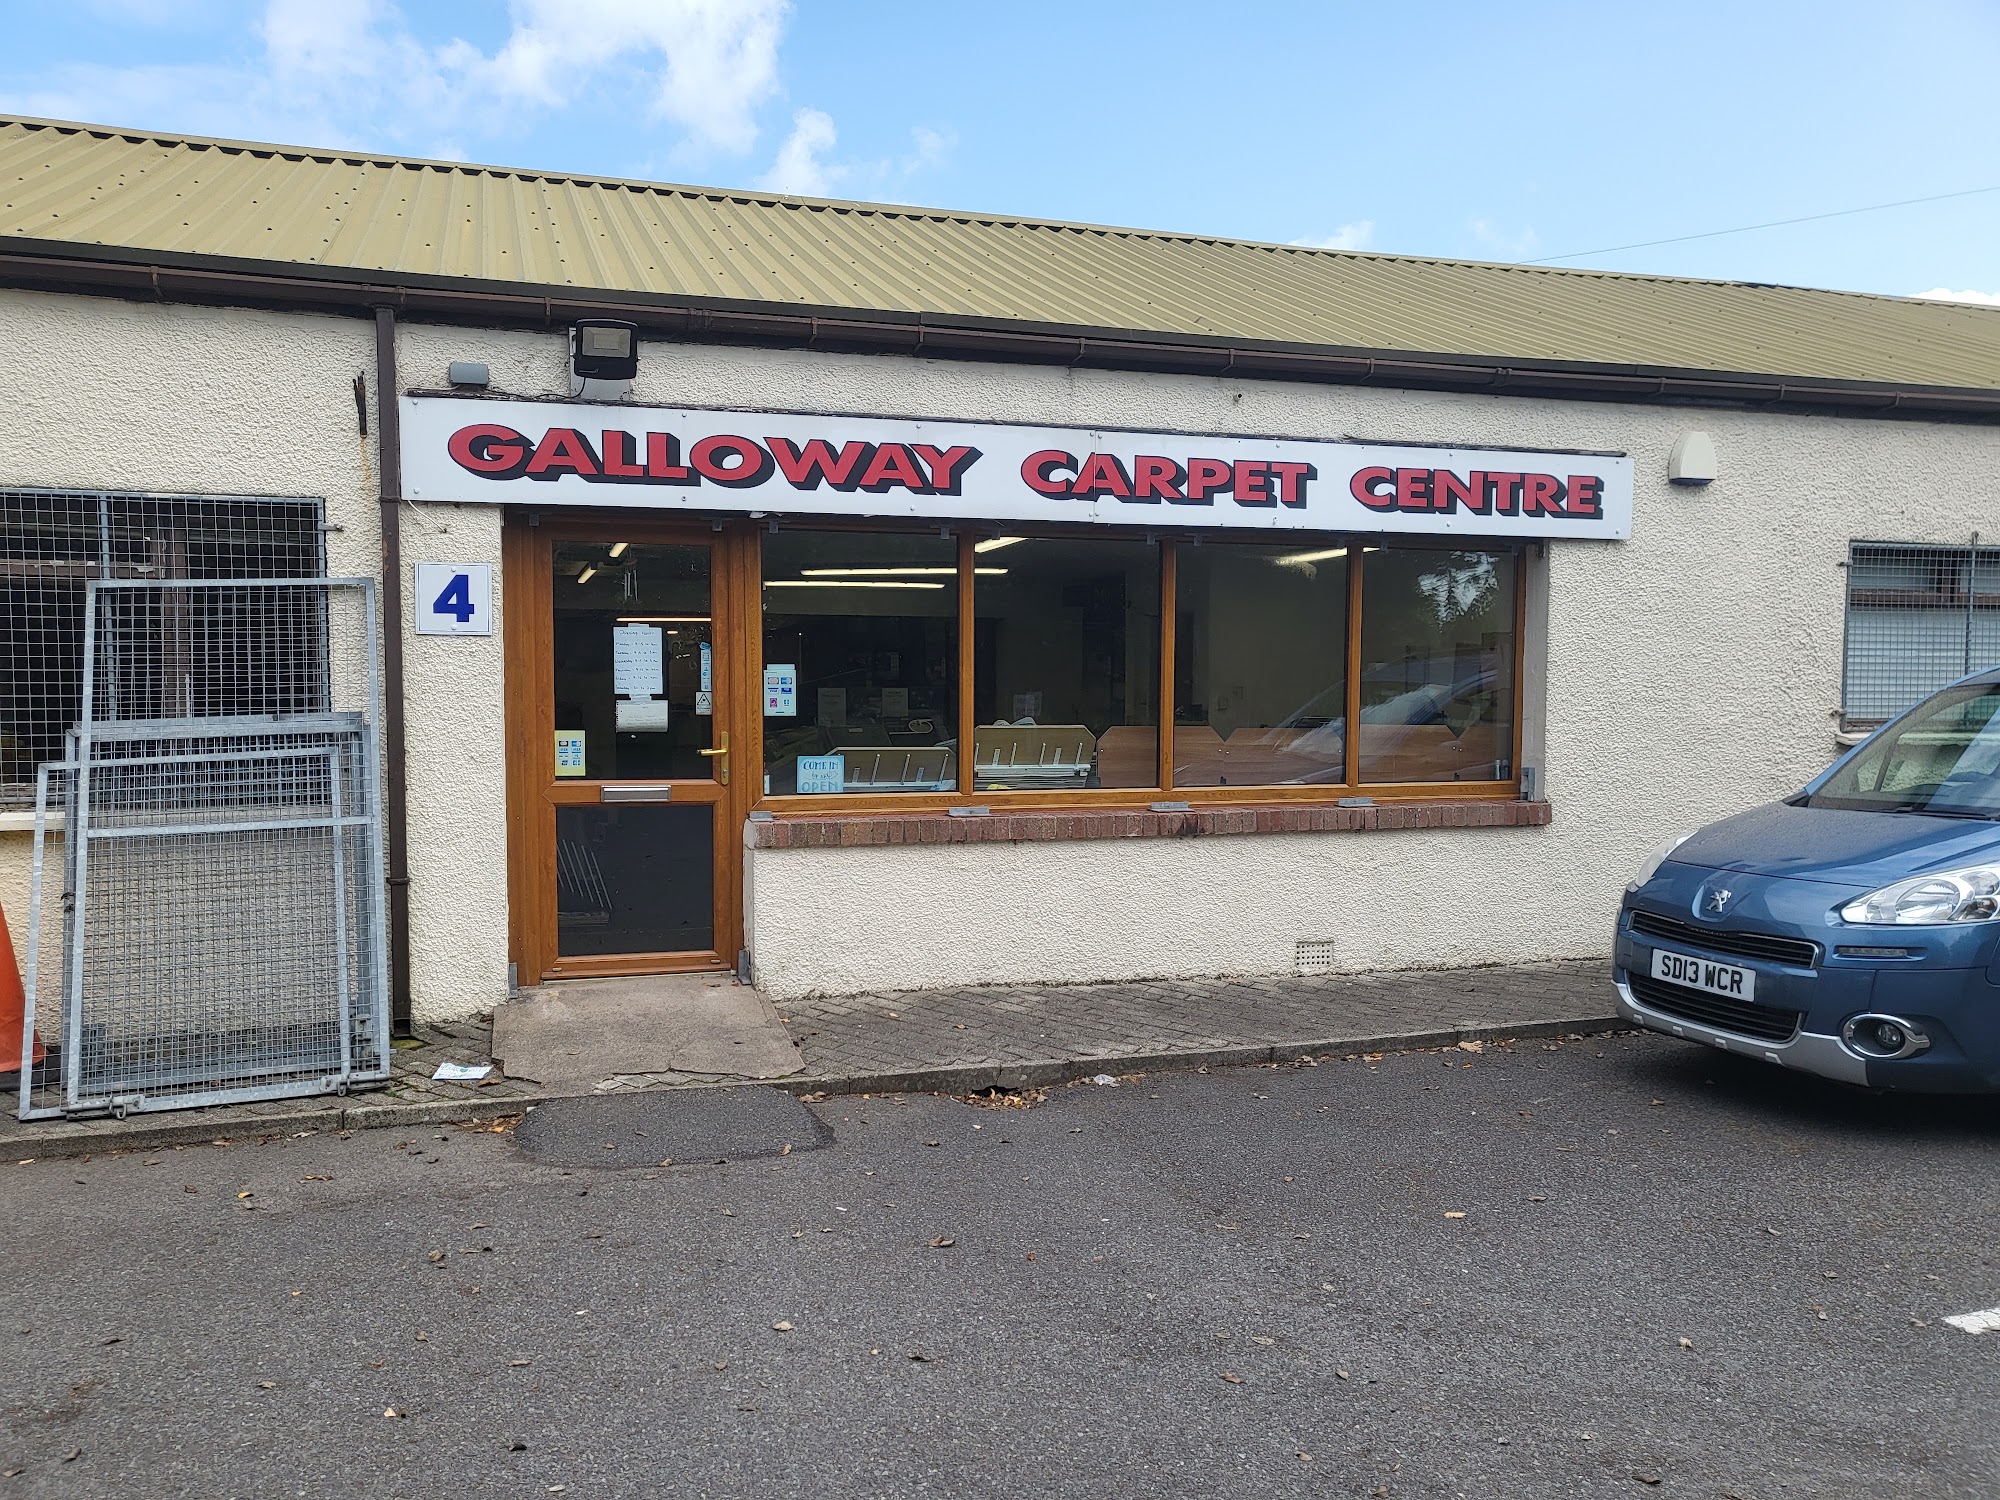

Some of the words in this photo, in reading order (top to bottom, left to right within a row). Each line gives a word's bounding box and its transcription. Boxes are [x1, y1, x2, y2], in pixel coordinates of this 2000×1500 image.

[447, 423, 983, 497] GALLOWAY
[1021, 448, 1318, 510] CARPET
[1349, 465, 1605, 520] CENTRE
[432, 574, 475, 623] 4
[803, 761, 827, 770] COME
[829, 761, 839, 770] IN
[801, 781, 838, 792] OPEN
[1661, 954, 1700, 983] SD13
[1705, 964, 1743, 994] WCR
